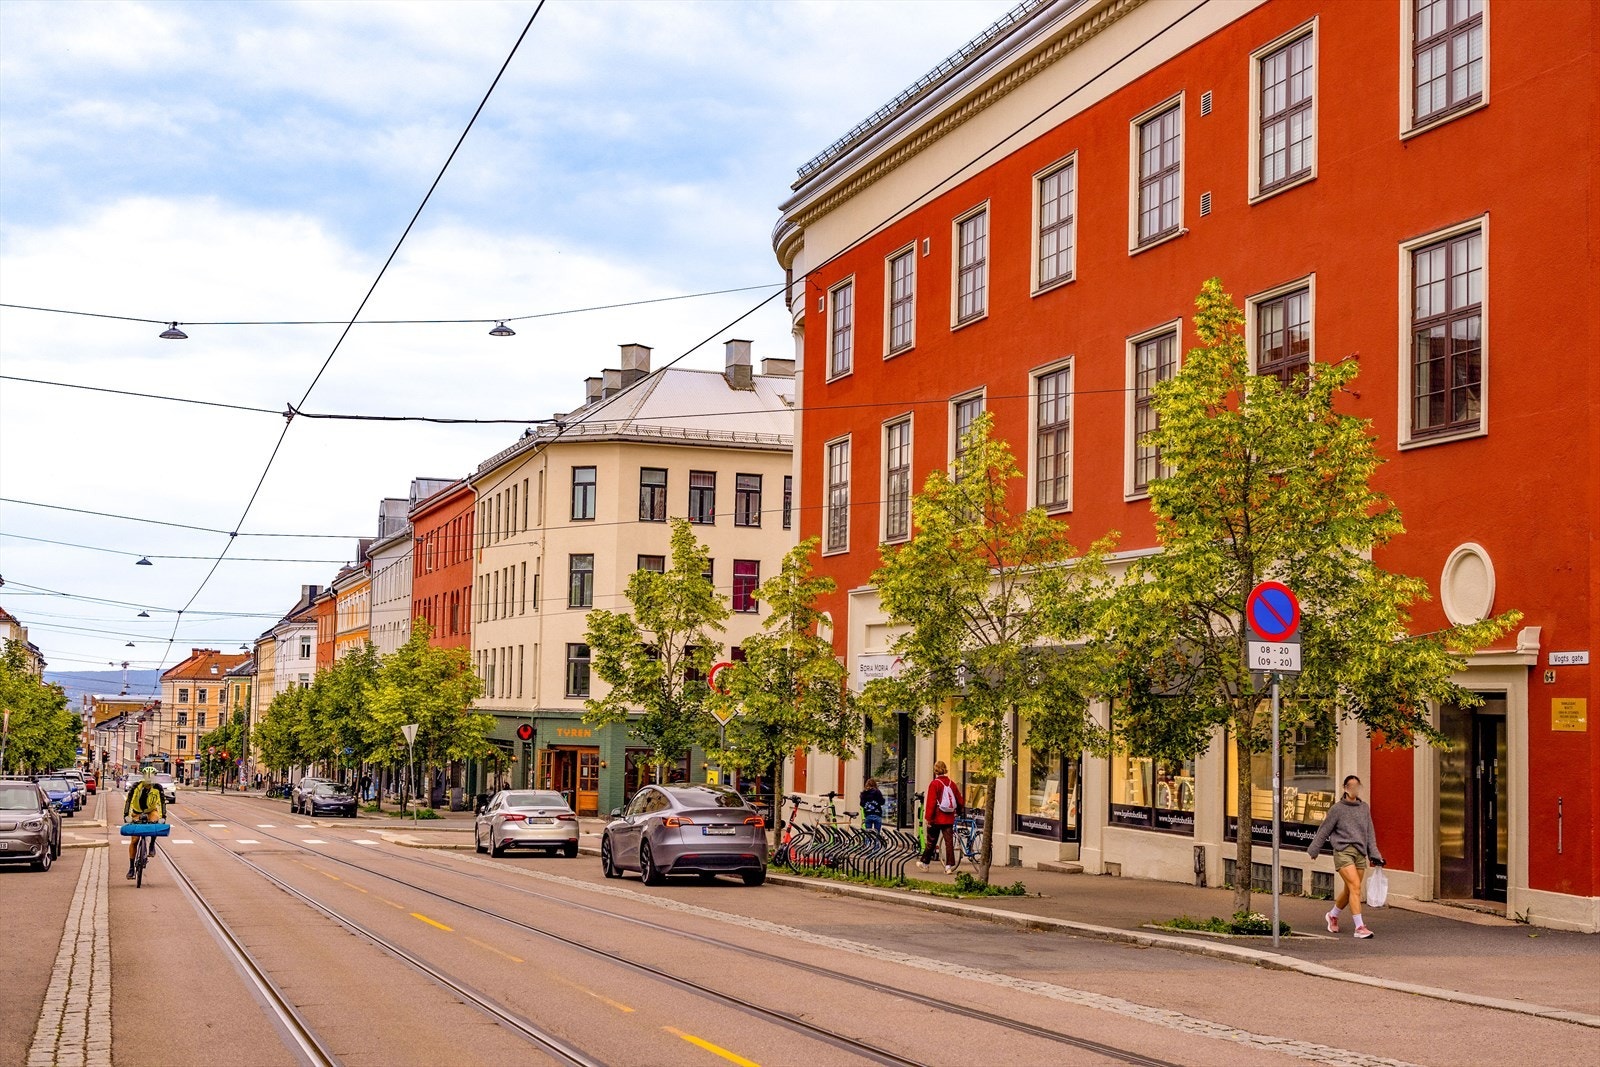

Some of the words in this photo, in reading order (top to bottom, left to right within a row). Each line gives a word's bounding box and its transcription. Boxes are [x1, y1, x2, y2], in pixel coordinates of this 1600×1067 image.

[1258, 656, 1270, 665] (09
[1280, 658, 1292, 667] 20)
[1554, 654, 1569, 663] Vogts
[1572, 655, 1583, 663] gate
[1545, 671, 1554, 682] 64
[556, 726, 592, 737] TYREN
